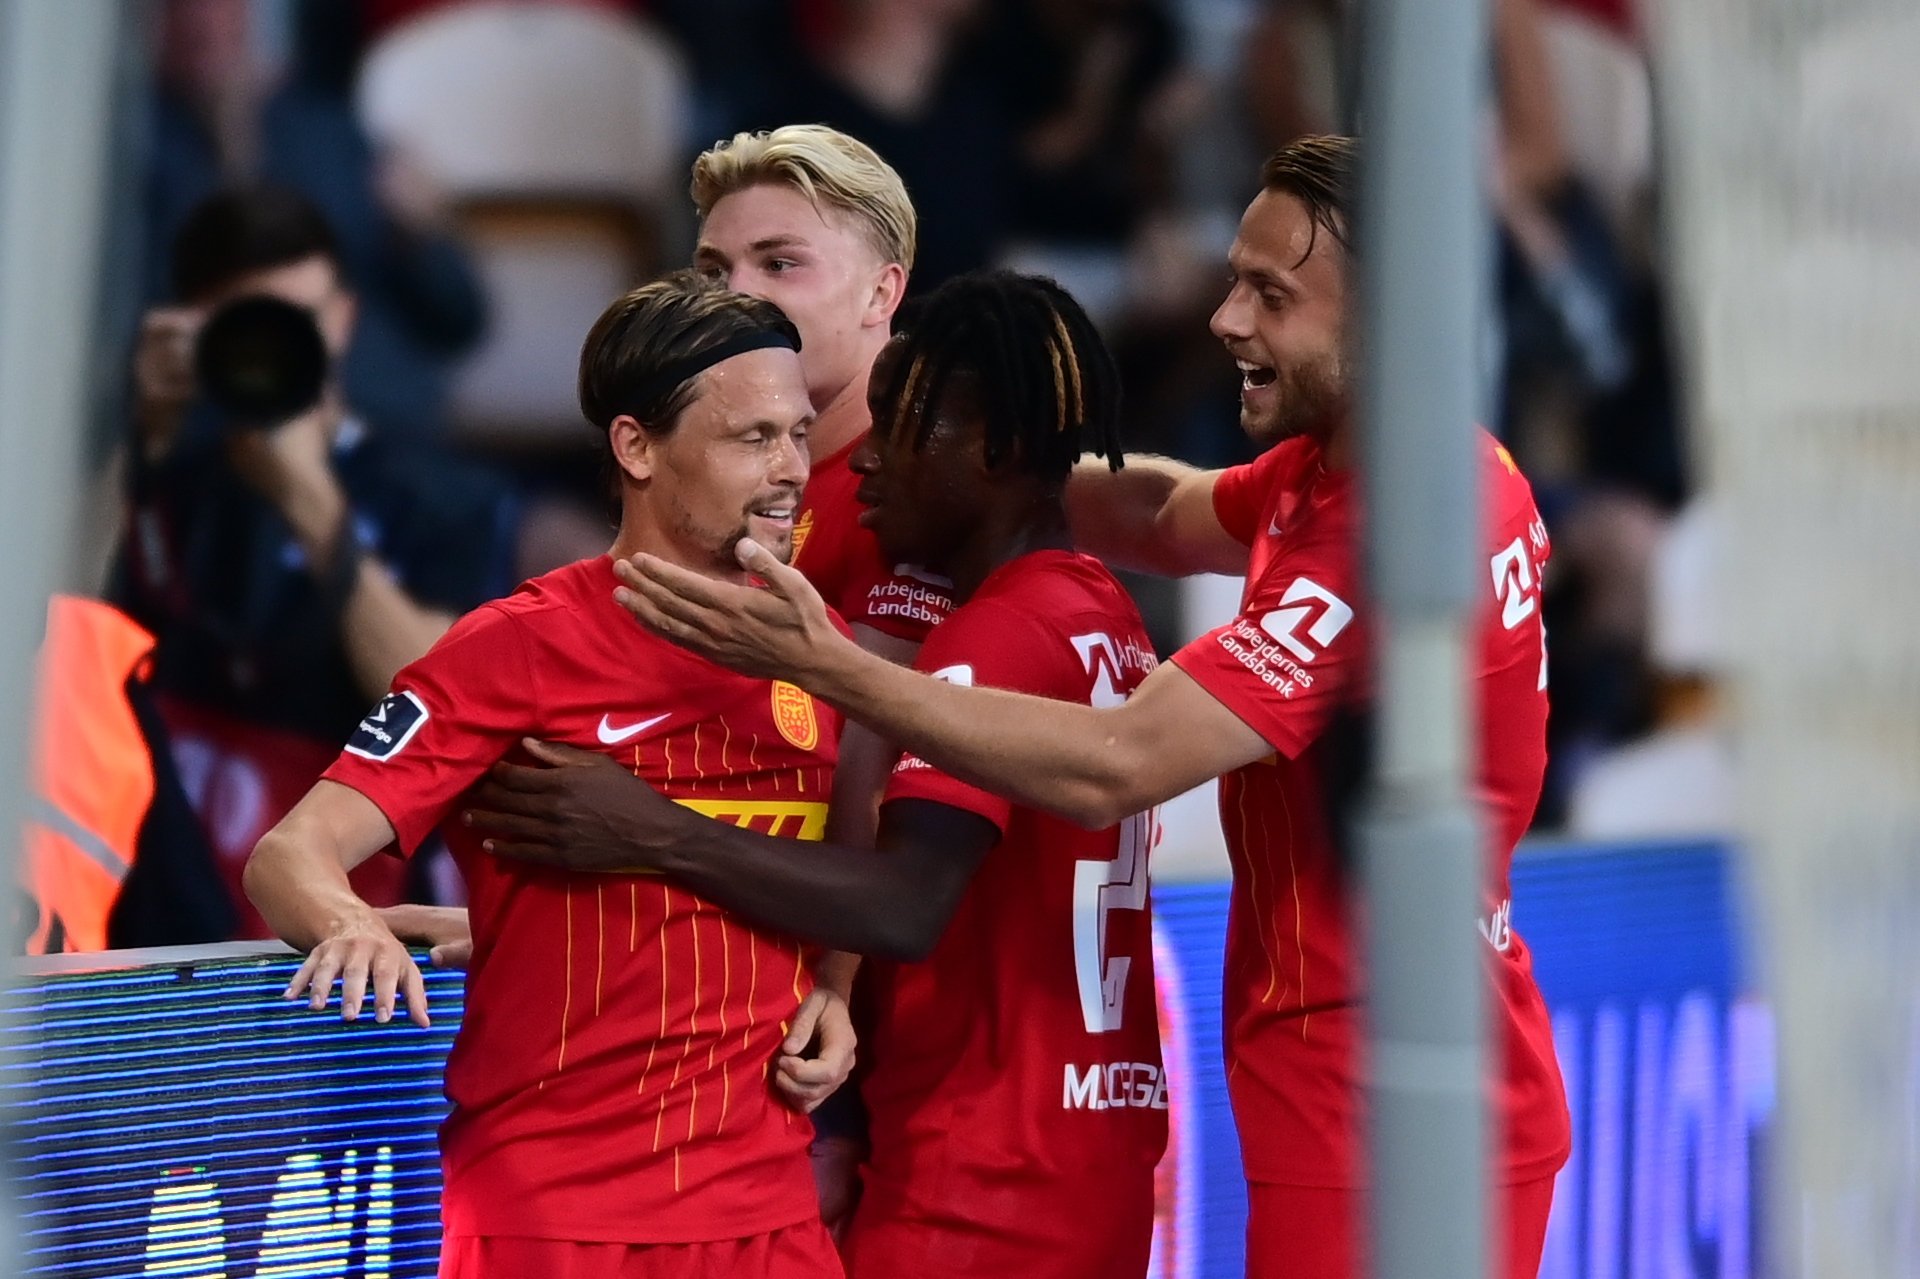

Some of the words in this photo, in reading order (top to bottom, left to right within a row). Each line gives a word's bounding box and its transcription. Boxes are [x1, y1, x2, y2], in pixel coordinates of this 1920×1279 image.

[867, 601, 945, 625] Landsba
[1216, 630, 1295, 699] Landsbank
[1232, 618, 1314, 688] Arbejdernes
